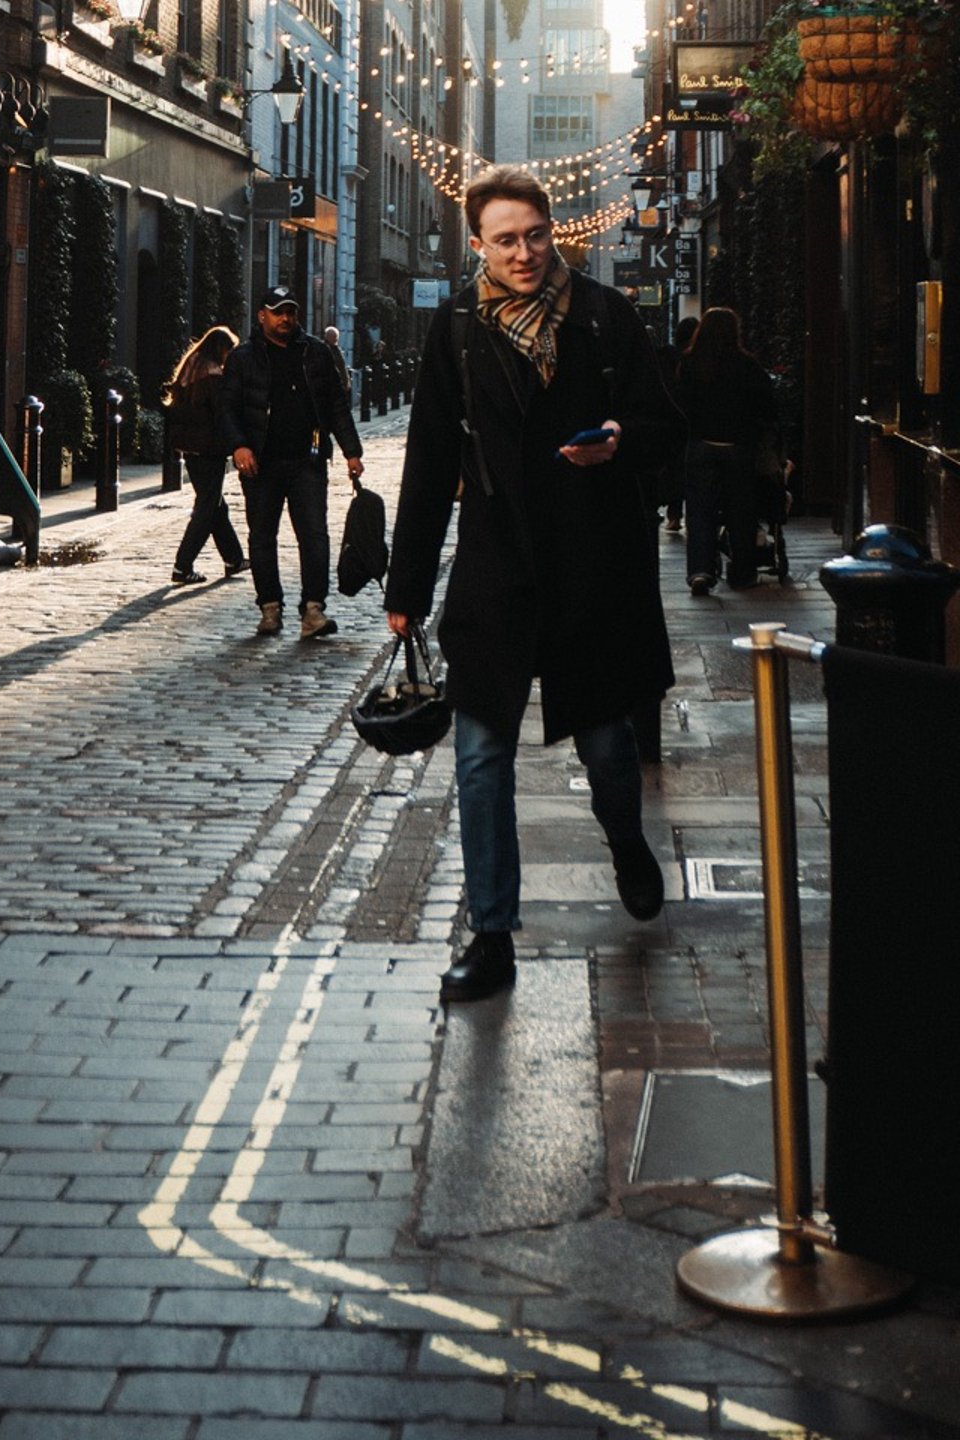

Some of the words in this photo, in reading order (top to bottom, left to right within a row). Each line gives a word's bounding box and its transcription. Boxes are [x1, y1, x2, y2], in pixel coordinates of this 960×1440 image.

[680, 73, 708, 88] Paul
[668, 109, 690, 121] Paul
[675, 239, 691, 250] Ba
[649, 244, 669, 268] K
[675, 268, 691, 279] ba
